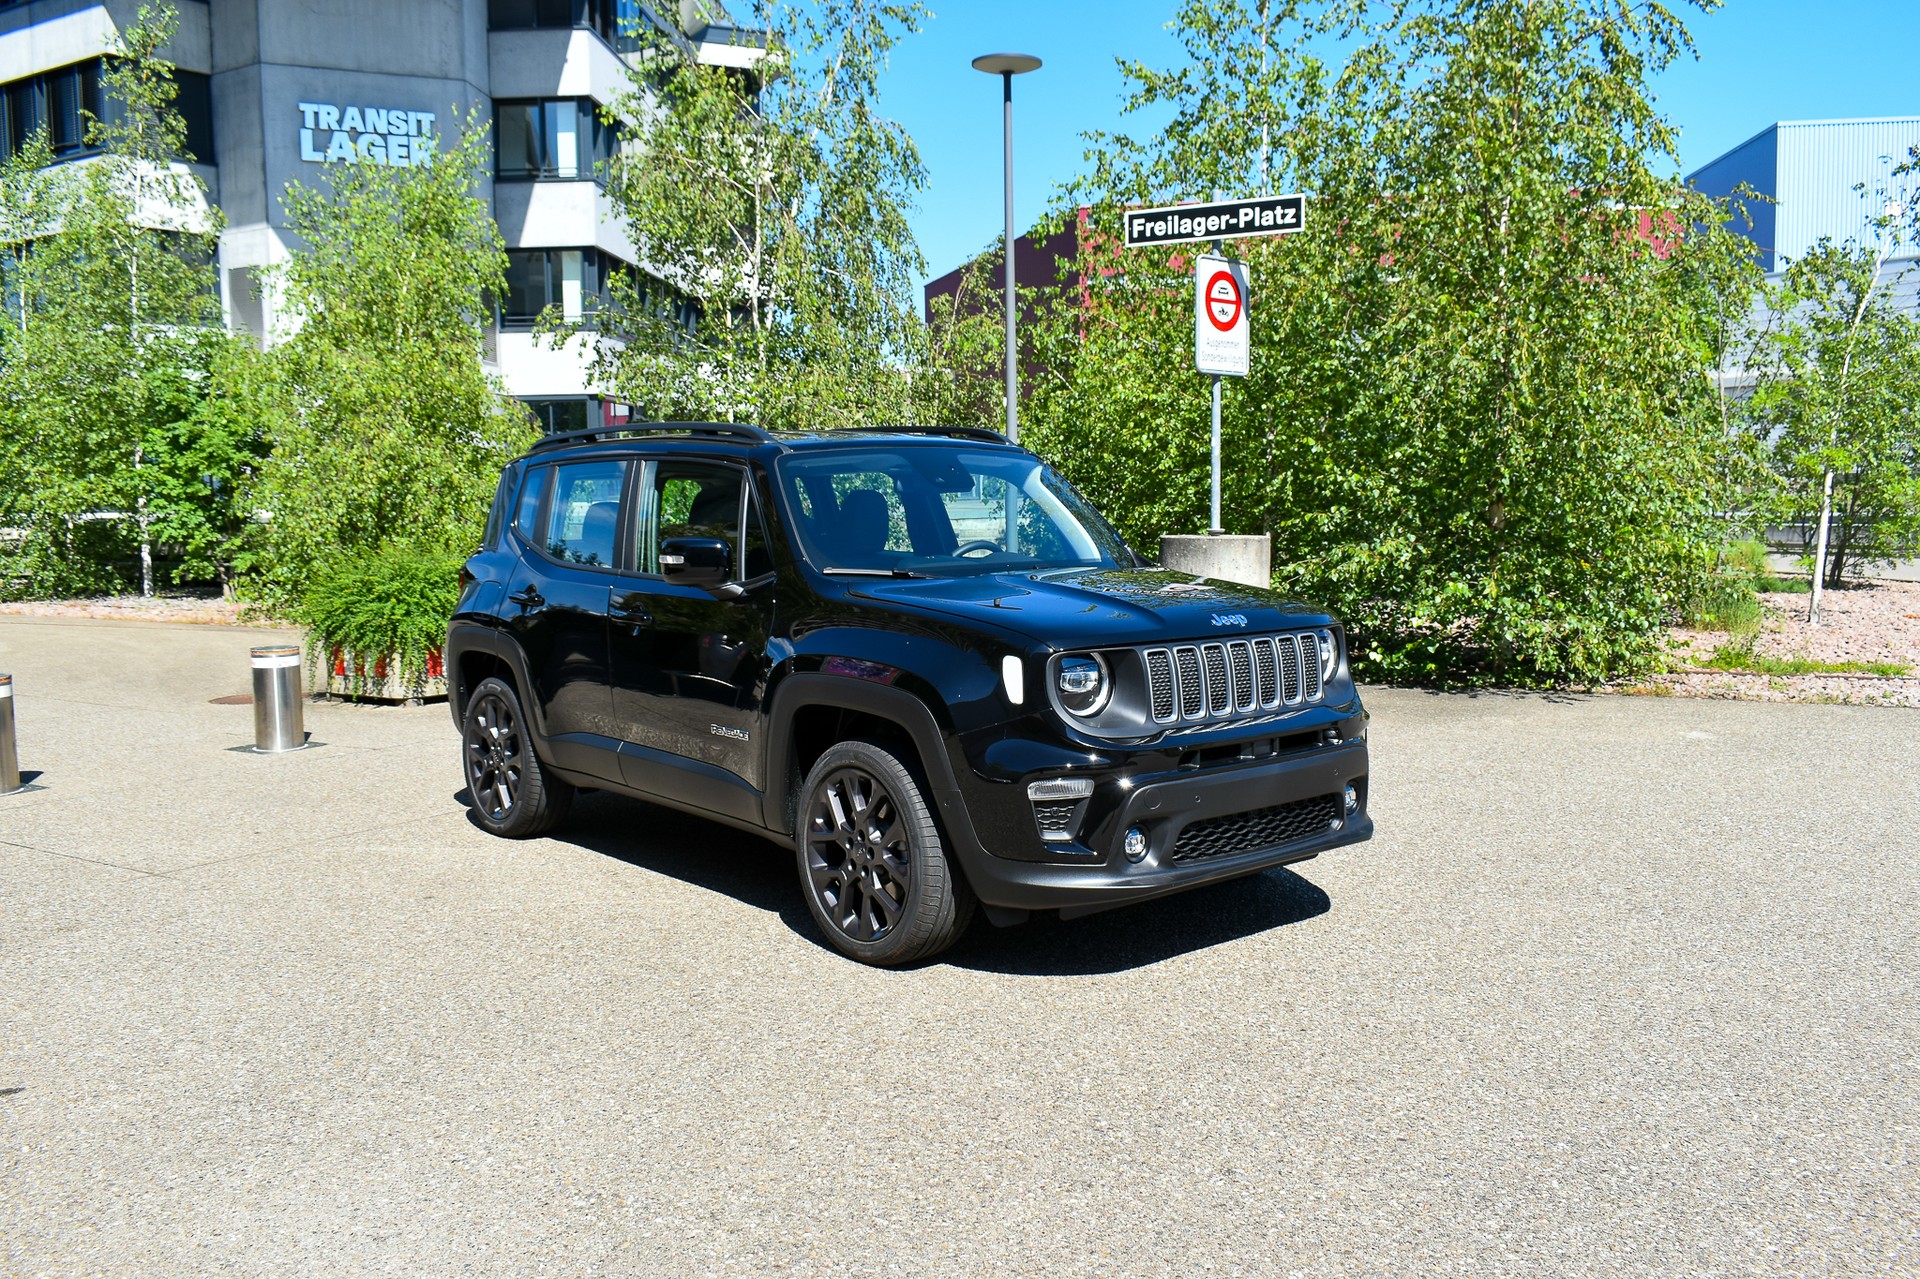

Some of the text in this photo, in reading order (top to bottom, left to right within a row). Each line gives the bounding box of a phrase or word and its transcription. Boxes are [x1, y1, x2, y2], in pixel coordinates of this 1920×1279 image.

[298, 102, 435, 137] TRANSIT
[300, 128, 435, 168] LAGER
[1132, 205, 1297, 237] Freilager-Platz
[1211, 613, 1248, 627] Jeep
